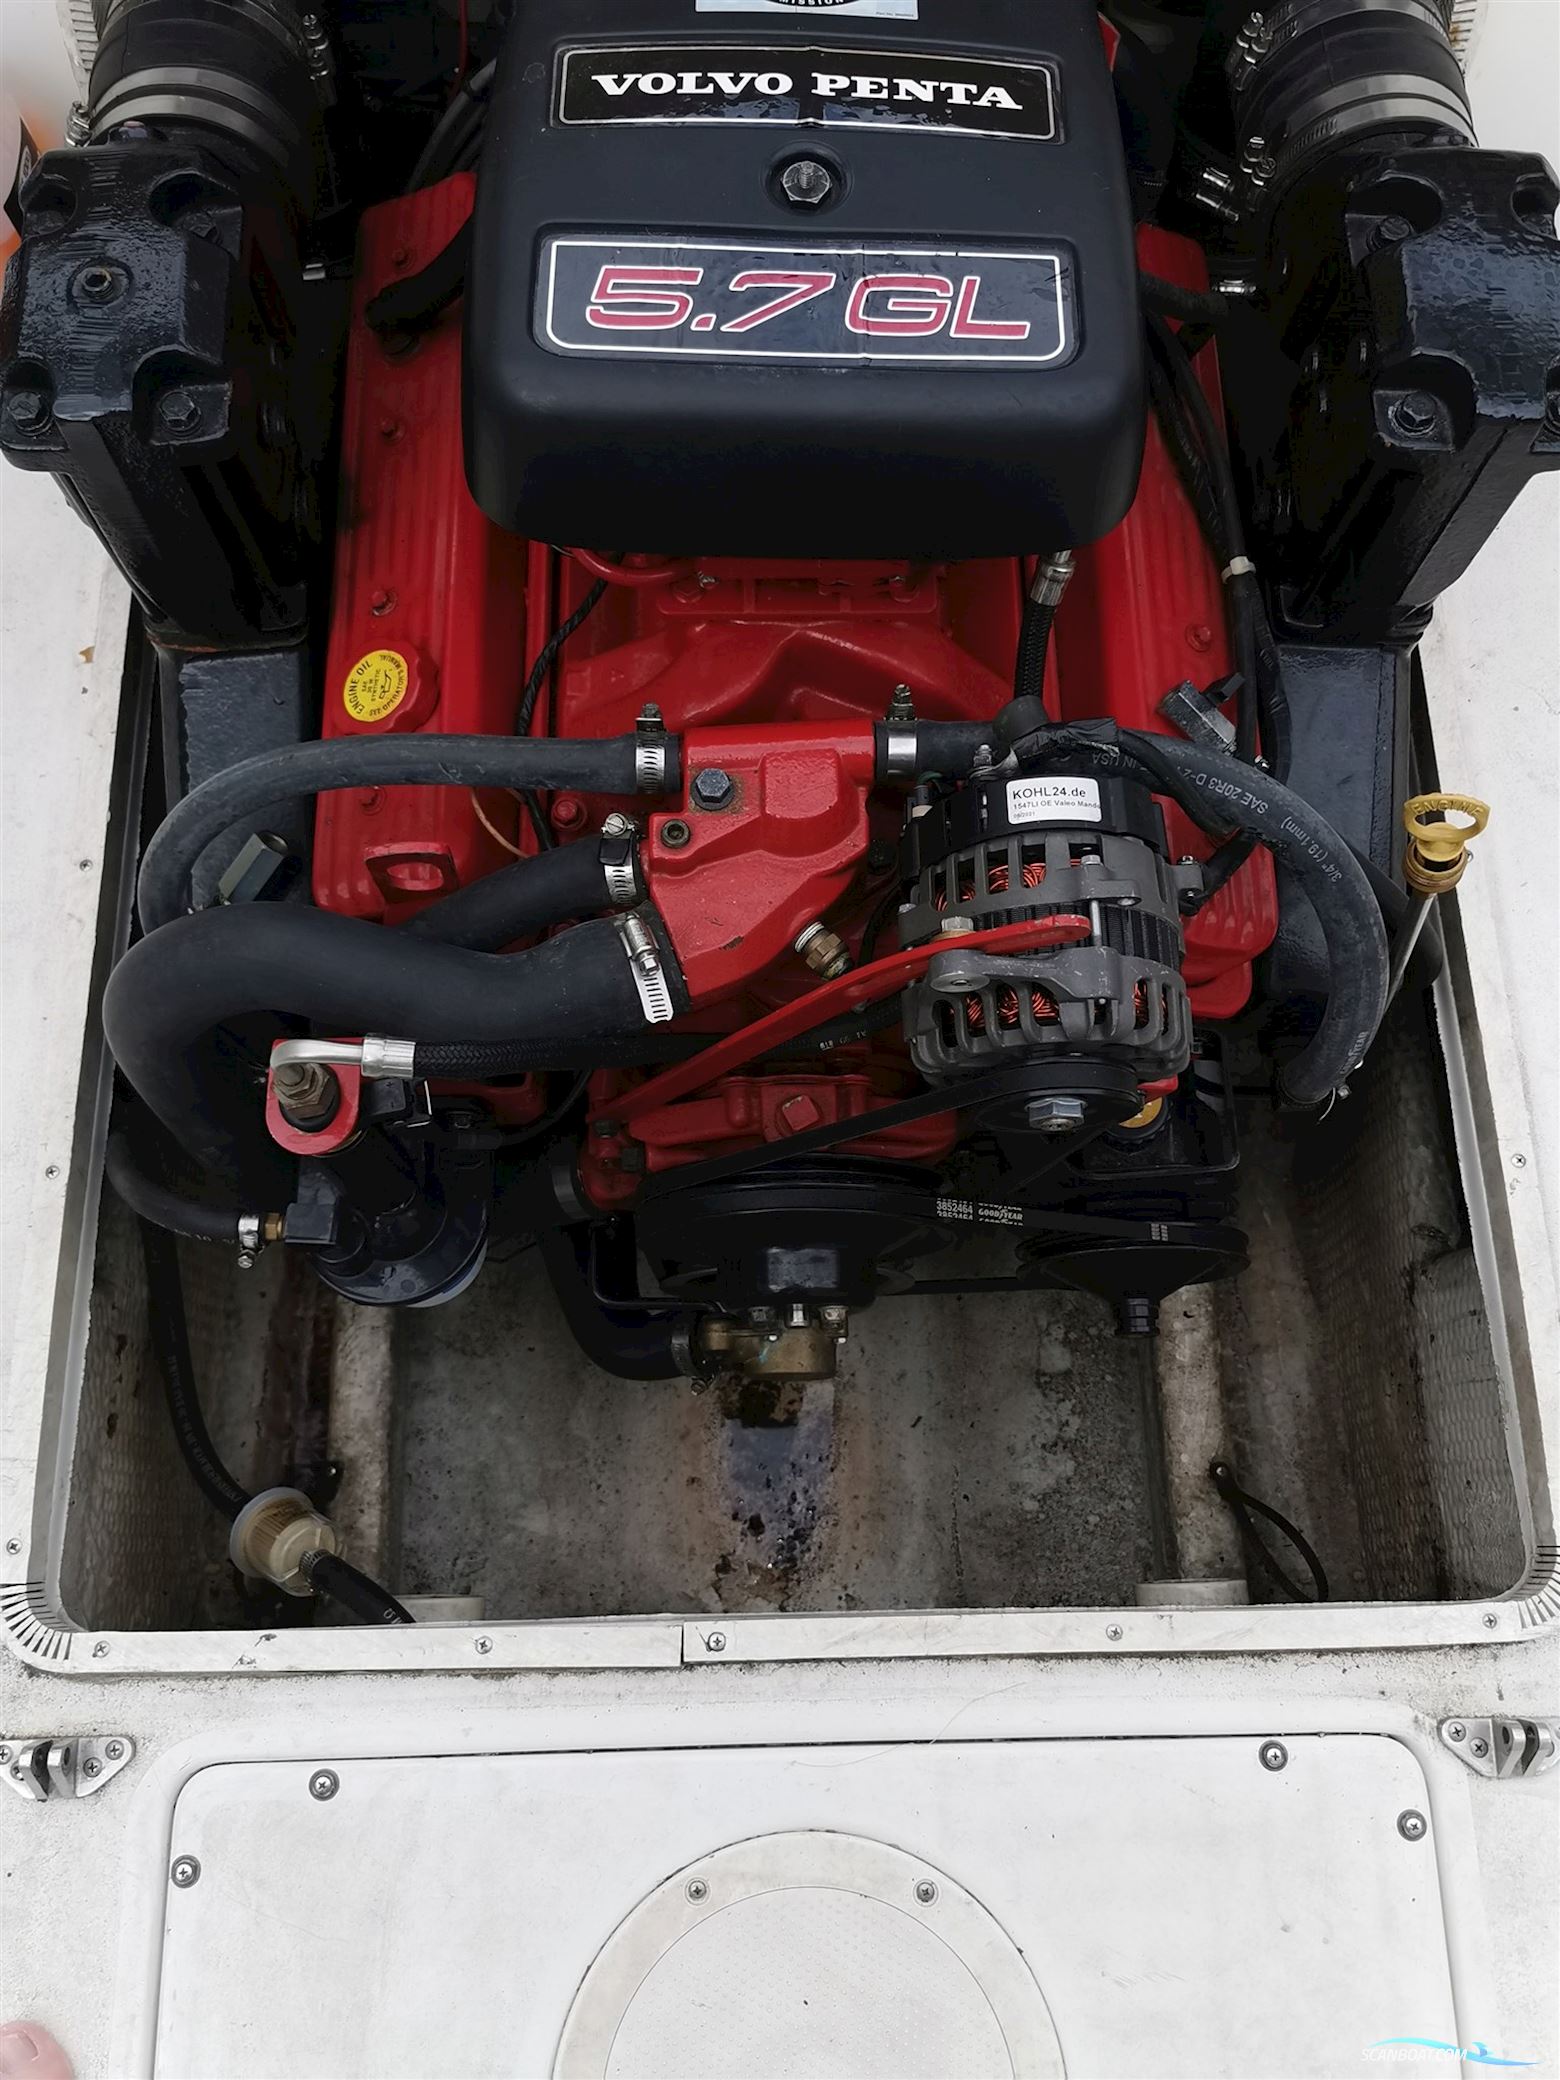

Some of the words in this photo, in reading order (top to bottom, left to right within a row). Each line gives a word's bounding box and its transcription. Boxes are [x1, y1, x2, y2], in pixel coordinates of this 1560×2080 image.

[591, 72, 793, 96] VOLVO
[811, 72, 1023, 110] PENTA
[356, 660, 372, 676] OIL
[348, 678, 365, 713] ENGINE
[1091, 751, 1120, 766] USA
[1012, 787, 1086, 800] KOHL24.de
[1208, 777, 1241, 799] 20R3
[1240, 791, 1269, 815] SAE
[1279, 815, 1329, 862] (19.1mm)
[936, 1200, 973, 1214] 3852464
[978, 1207, 1023, 1221] GOODYEAR
